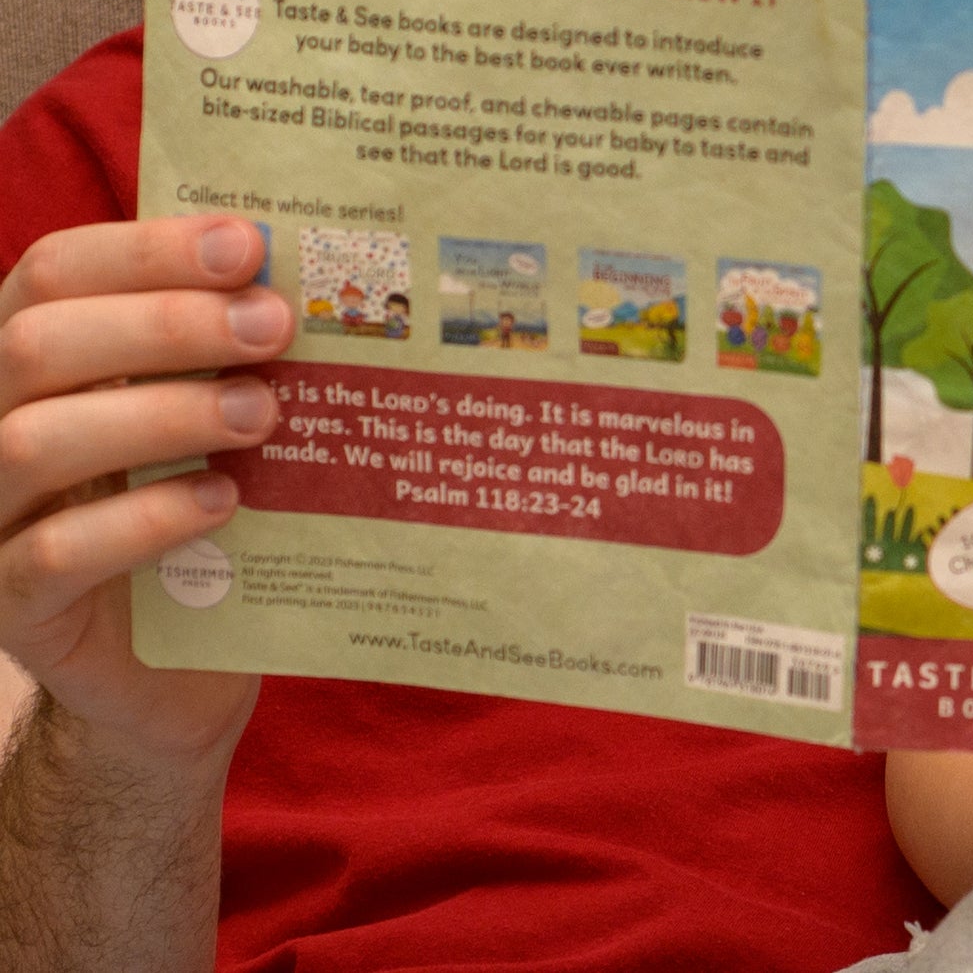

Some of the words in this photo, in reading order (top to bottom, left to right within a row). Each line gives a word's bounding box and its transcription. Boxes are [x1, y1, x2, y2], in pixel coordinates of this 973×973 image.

[295, 32, 342, 54] your
[347, 34, 399, 62] baby
[405, 41, 425, 62] to
[432, 40, 467, 66] the
[474, 43, 524, 70] best
[530, 50, 584, 73] book
[591, 59, 641, 77] ever
[647, 59, 738, 85] written.
[336, 5, 348, 25] &
[354, 5, 392, 29] See
[399, 8, 462, 37] books
[467, 20, 505, 40] are
[510, 21, 618, 49] designed
[624, 30, 647, 50] to
[652, 31, 764, 60] introduce
[200, 67, 240, 90] Our
[360, 85, 404, 108] tear
[410, 89, 474, 116] proof,
[480, 95, 526, 118] and
[531, 98, 644, 125] chewable
[651, 109, 721, 133] pages
[726, 113, 815, 140] contain
[202, 96, 304, 126] bite-sized
[312, 106, 396, 135] Biblical
[399, 119, 510, 146] passages
[515, 122, 546, 145] for
[552, 129, 604, 153] your
[610, 130, 669, 158] baby
[673, 137, 696, 157] to
[700, 138, 759, 163] taste
[765, 145, 811, 169] and
[355, 143, 393, 164] see
[399, 142, 449, 167] that
[453, 145, 491, 170] the
[498, 148, 547, 174] Lord
[554, 154, 571, 175] is
[577, 157, 642, 182] good.
[176, 183, 238, 209] Collect
[242, 189, 272, 212] the
[277, 193, 332, 219] whole
[338, 200, 405, 223] series!
[298, 380, 319, 403] is
[325, 382, 366, 407] the
[456, 394, 532, 426] doing.
[540, 400, 563, 424] It
[570, 403, 592, 426] is
[599, 409, 724, 440] marvelous
[731, 418, 755, 443] in
[261, 439, 338, 464] made.
[343, 443, 385, 469] We
[390, 450, 432, 474] will
[439, 456, 522, 483] rejoice
[527, 463, 576, 487] and
[580, 465, 610, 491] be
[615, 472, 670, 498] glad
[675, 476, 700, 501] in
[704, 479, 734, 504] it!
[289, 415, 353, 438] eyes.
[357, 415, 409, 442] This
[416, 421, 437, 444] is
[442, 423, 482, 448] the
[489, 428, 534, 458] day
[540, 432, 594, 458] that
[599, 435, 641, 462] the
[709, 447, 755, 475] has
[395, 480, 470, 507] Psalm
[240, 551, 290, 565] Copyright
[349, 631, 663, 680] www.TasteAndSeeBooks.com
